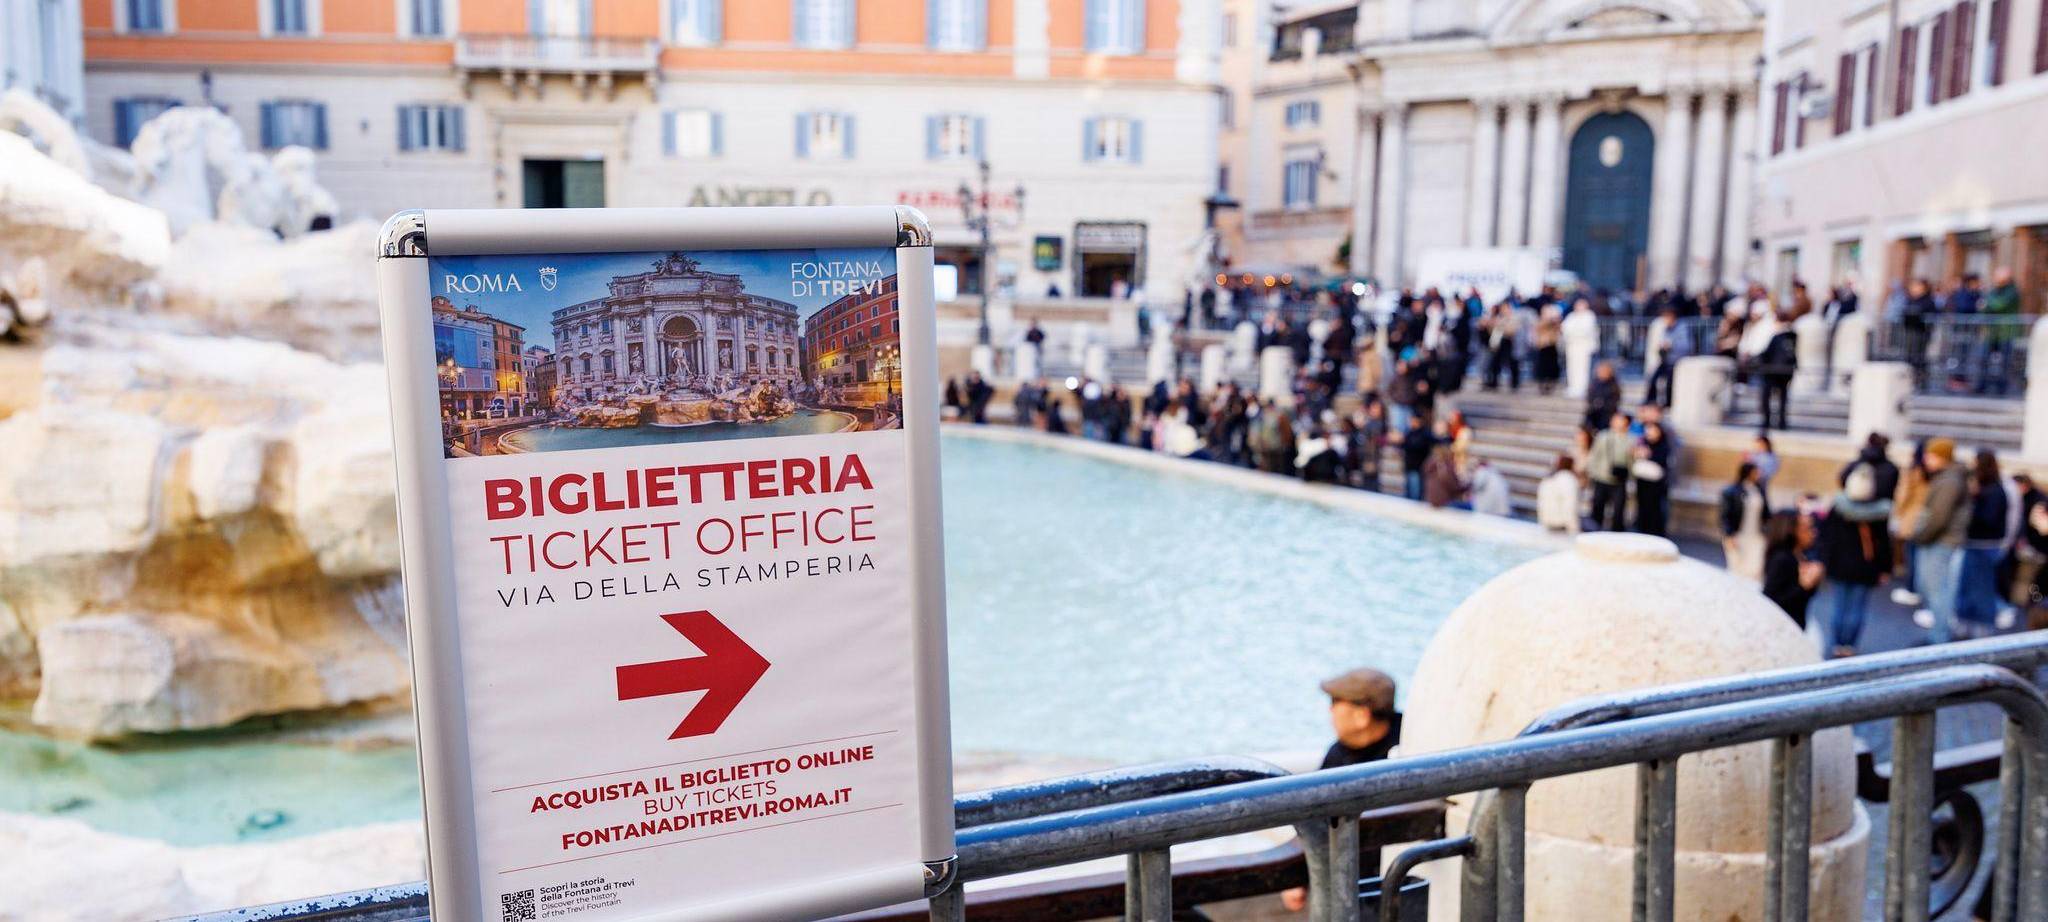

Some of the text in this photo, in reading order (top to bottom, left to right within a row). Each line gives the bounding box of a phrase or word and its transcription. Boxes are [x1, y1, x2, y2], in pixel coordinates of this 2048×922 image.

[791, 261, 883, 279] FONTANA
[445, 273, 522, 293] ROMA
[792, 279, 883, 297] DI TREVI
[485, 453, 874, 521] BIGLIETTERIA
[490, 505, 877, 575] TICKET OFFICE
[497, 553, 875, 608] VIA DELLA STAMPERIA
[531, 745, 874, 814] ACQUISTA IL BIGLIETTO ONLINE
[644, 780, 777, 816] BUY TICKETS
[562, 788, 853, 850] FONTANADITREVI.ROMA.IT
[540, 877, 605, 895] Scopri la storia
[540, 878, 635, 903] della Fontana di Trevi
[541, 892, 618, 911] Discover the history
[541, 899, 622, 919] of the Trevi Fountain
